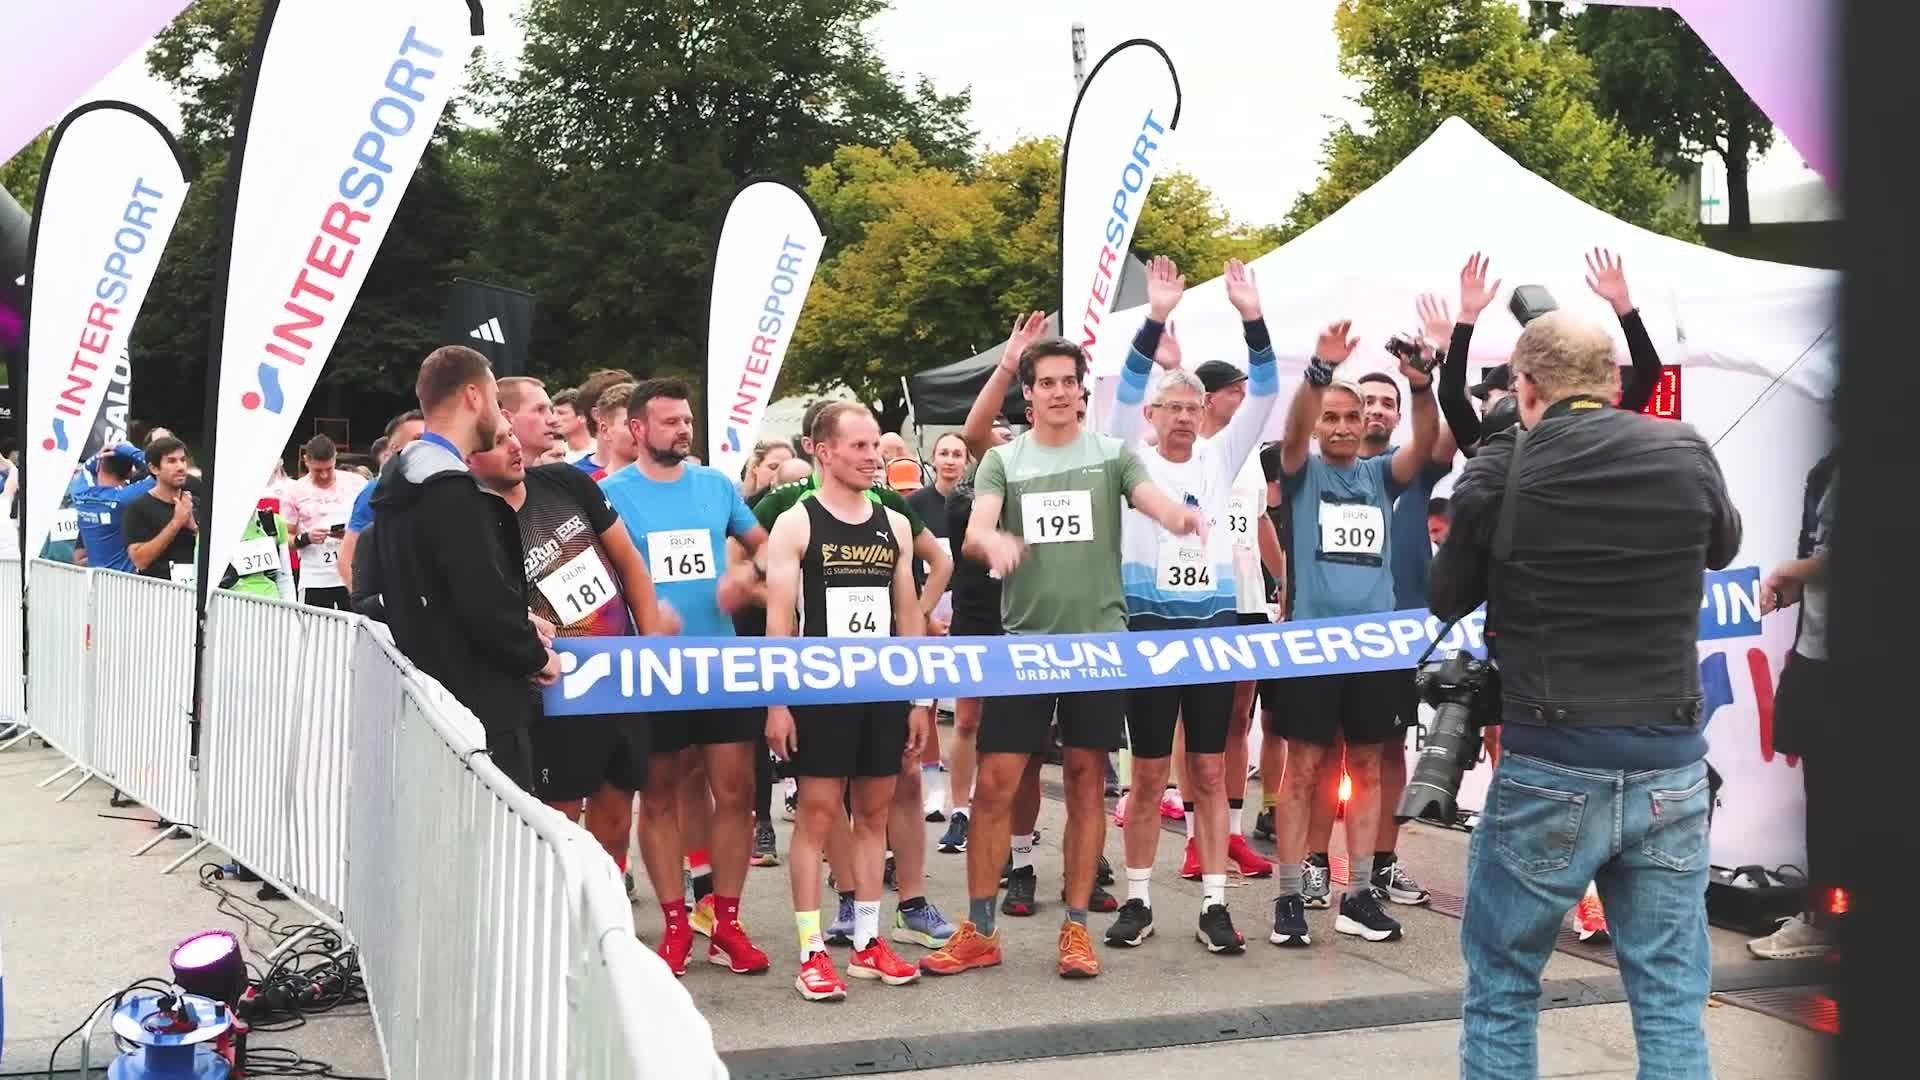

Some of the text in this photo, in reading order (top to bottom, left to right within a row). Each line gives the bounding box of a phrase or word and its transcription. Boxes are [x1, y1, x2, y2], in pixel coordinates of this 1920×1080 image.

[265, 26, 444, 366] INTERSPORT
[1078, 109, 1164, 375] NTERSPORT
[56, 177, 163, 416] INTERSPORT
[729, 233, 806, 425] INTERSPORT
[104, 345, 131, 448] SALO
[1043, 498, 1070, 507] RUN
[1036, 515, 1081, 537] 195
[1228, 514, 1247, 533] 33
[670, 537, 695, 545] RUN
[1334, 527, 1375, 547] 309
[243, 552, 273, 570] 370
[664, 553, 706, 576] 165
[562, 563, 587, 583] RUN
[1168, 566, 1210, 586] 384
[566, 576, 606, 613] 181
[849, 594, 874, 602] RUN
[848, 612, 876, 633] 64
[620, 645, 987, 698] INTERSPORT
[1008, 641, 1123, 669] RUN
[1016, 667, 1128, 681] URBAN TRAIL
